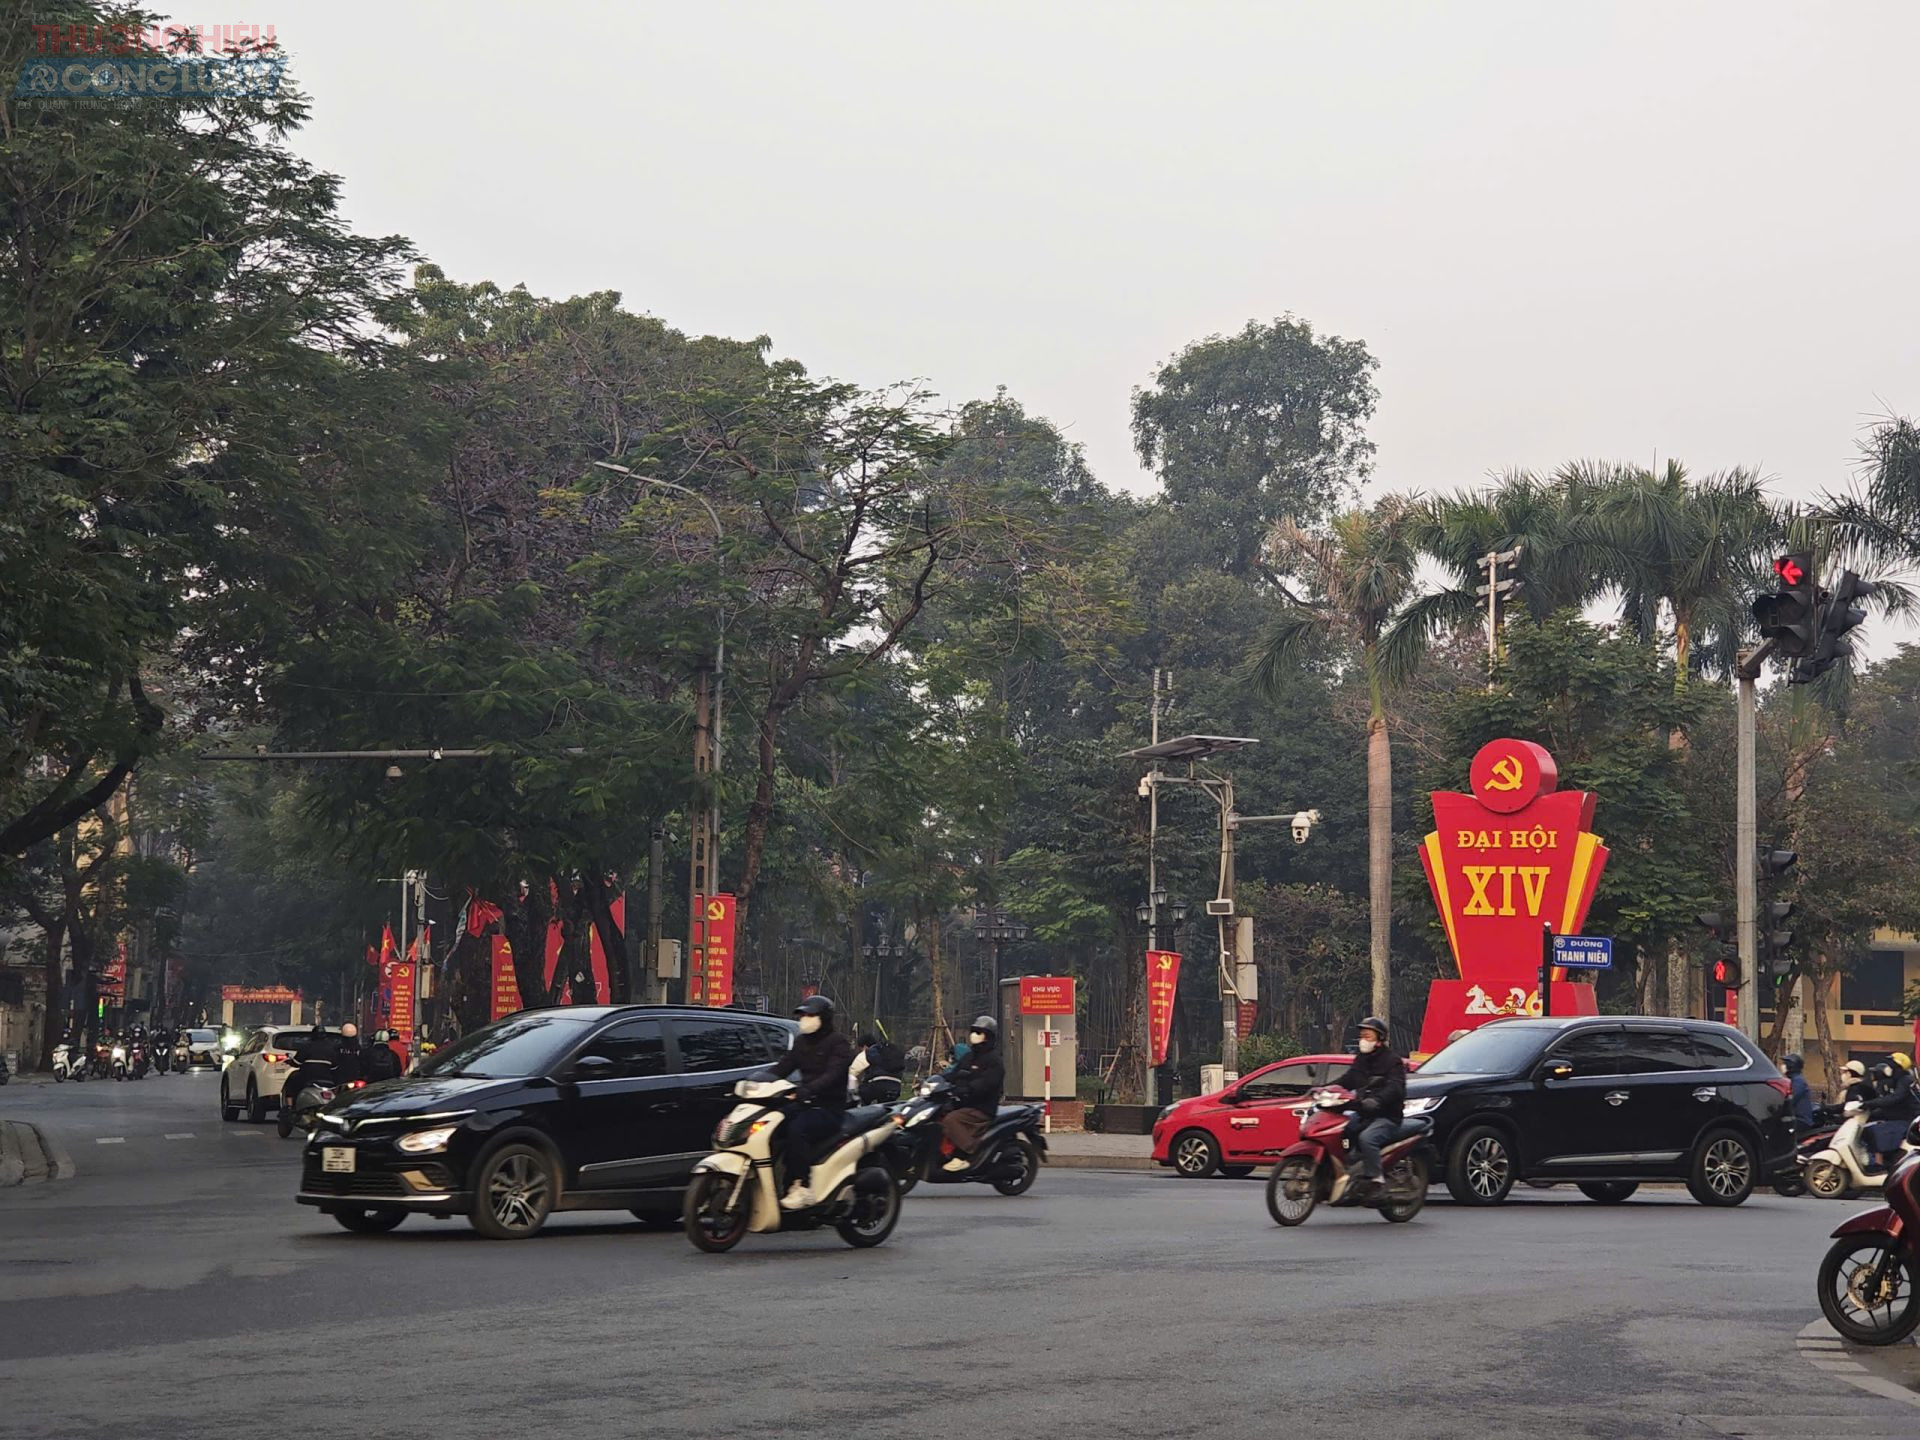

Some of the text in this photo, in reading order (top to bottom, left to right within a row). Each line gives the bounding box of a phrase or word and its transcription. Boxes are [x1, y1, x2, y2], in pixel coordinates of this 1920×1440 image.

[1457, 824, 1558, 854] ĐẠI HỘI
[1462, 865, 1551, 917] XIV
[1570, 939, 1603, 948] ĐƯỜNG
[1556, 949, 1609, 964] THANH NIÊN
